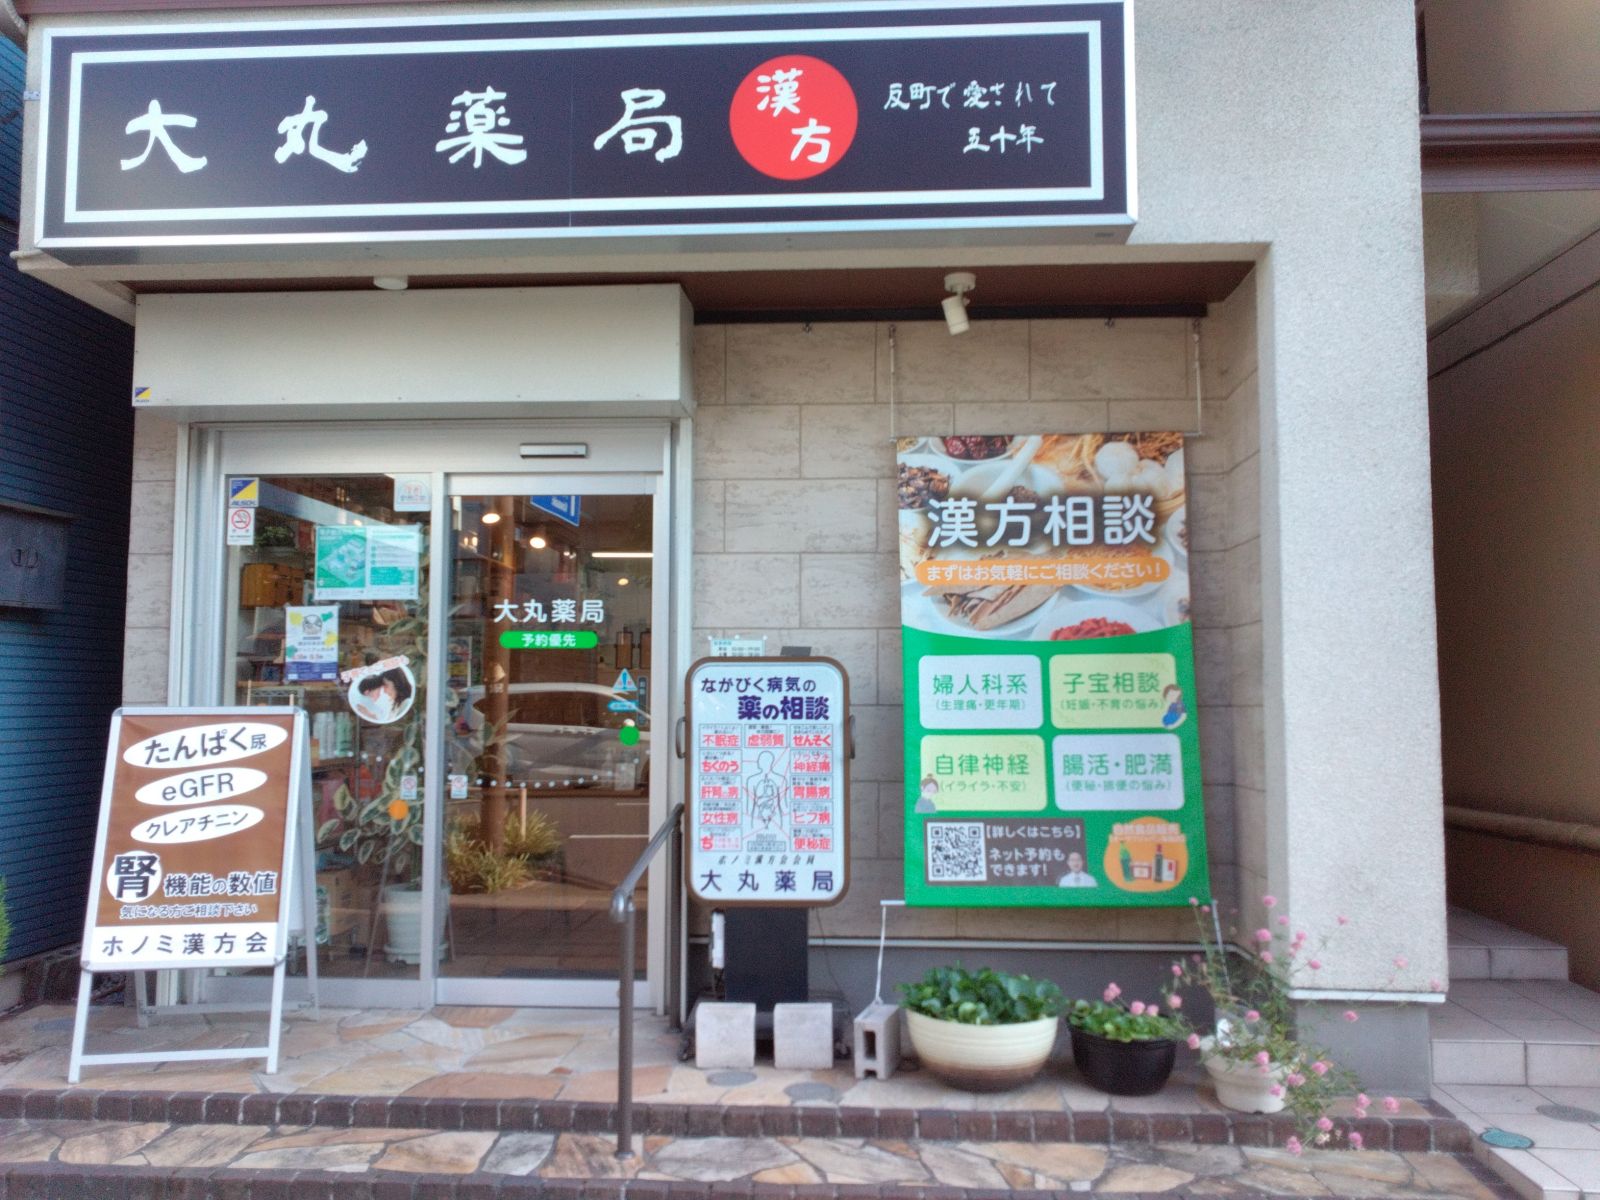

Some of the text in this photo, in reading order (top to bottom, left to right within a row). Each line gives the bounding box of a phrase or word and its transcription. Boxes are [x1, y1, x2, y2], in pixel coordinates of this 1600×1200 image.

[884, 81, 1057, 110] 反町で愛されて
[756, 68, 831, 163] 漢方
[121, 86, 682, 173] 大丸薬局
[963, 124, 1044, 153] 五十年
[927, 494, 1156, 548] 漢方相談
[493, 598, 604, 623] 大丸薬局
[521, 633, 576, 647] 予約優先
[701, 676, 816, 693] ながびく病気の
[932, 673, 1027, 695] 婦人科系
[1063, 672, 1161, 694] 子宝相談
[738, 695, 829, 720] 薬の相談
[144, 725, 267, 765] たんぱく尿
[702, 734, 739, 747] 不眠症
[702, 761, 739, 773] ちくのう
[936, 754, 1030, 776] 自律神経
[1062, 754, 1172, 776] 腸活・肥満
[162, 772, 234, 801] eGFR
[146, 811, 248, 839] クレアチニン
[793, 812, 830, 824] ヒフ病
[989, 847, 1065, 862] ネット予約も
[700, 869, 834, 892] 大丸薬局
[120, 904, 257, 919] 気になる方ご相談下さい
[102, 931, 268, 956] ホノミ漢方会
